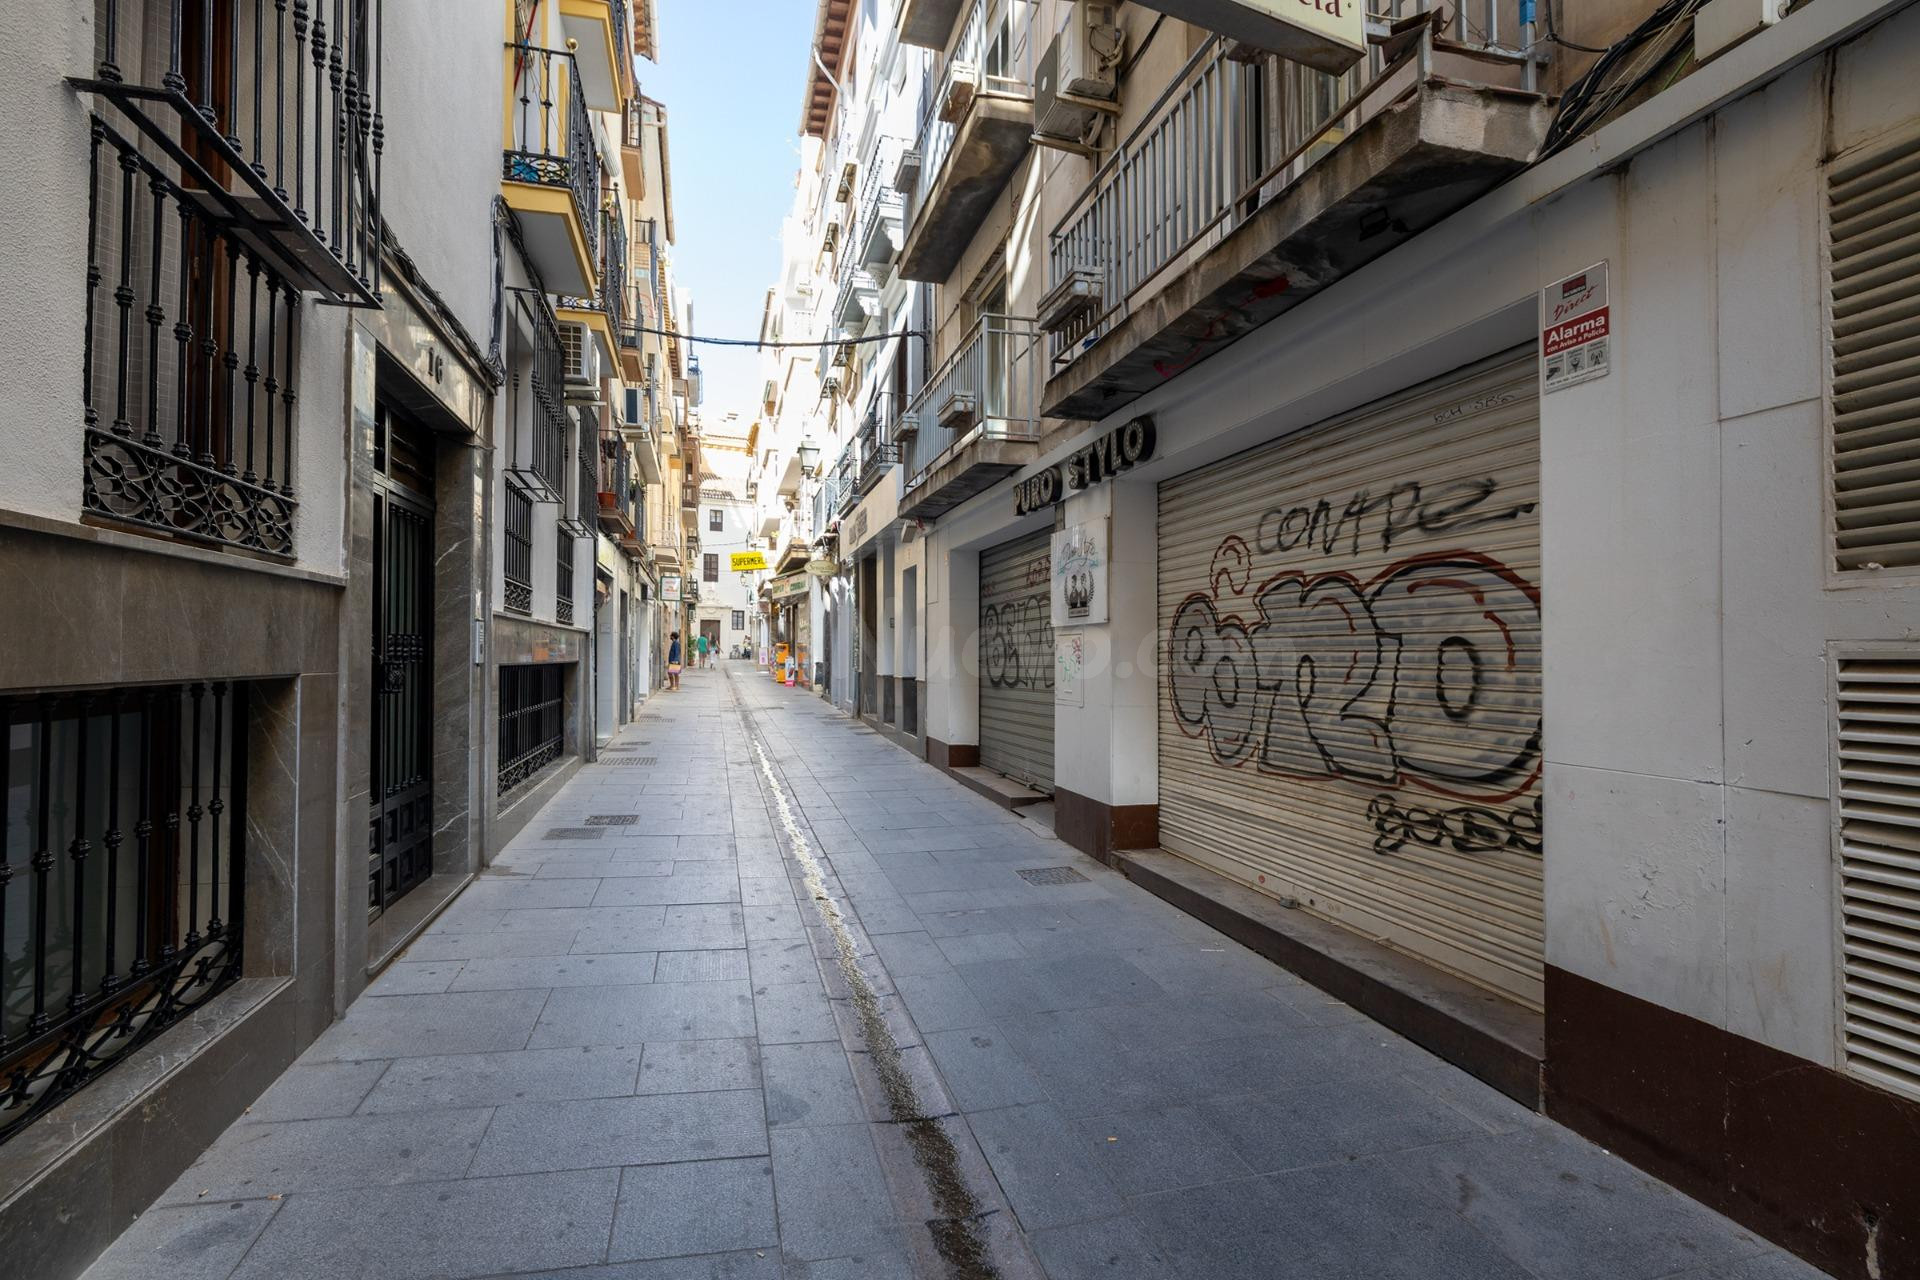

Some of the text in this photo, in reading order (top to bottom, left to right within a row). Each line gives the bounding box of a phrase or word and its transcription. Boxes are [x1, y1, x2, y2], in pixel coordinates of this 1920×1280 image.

[1547, 316, 1605, 345] Alarma
[1013, 415, 1156, 516] PURO STYLO
